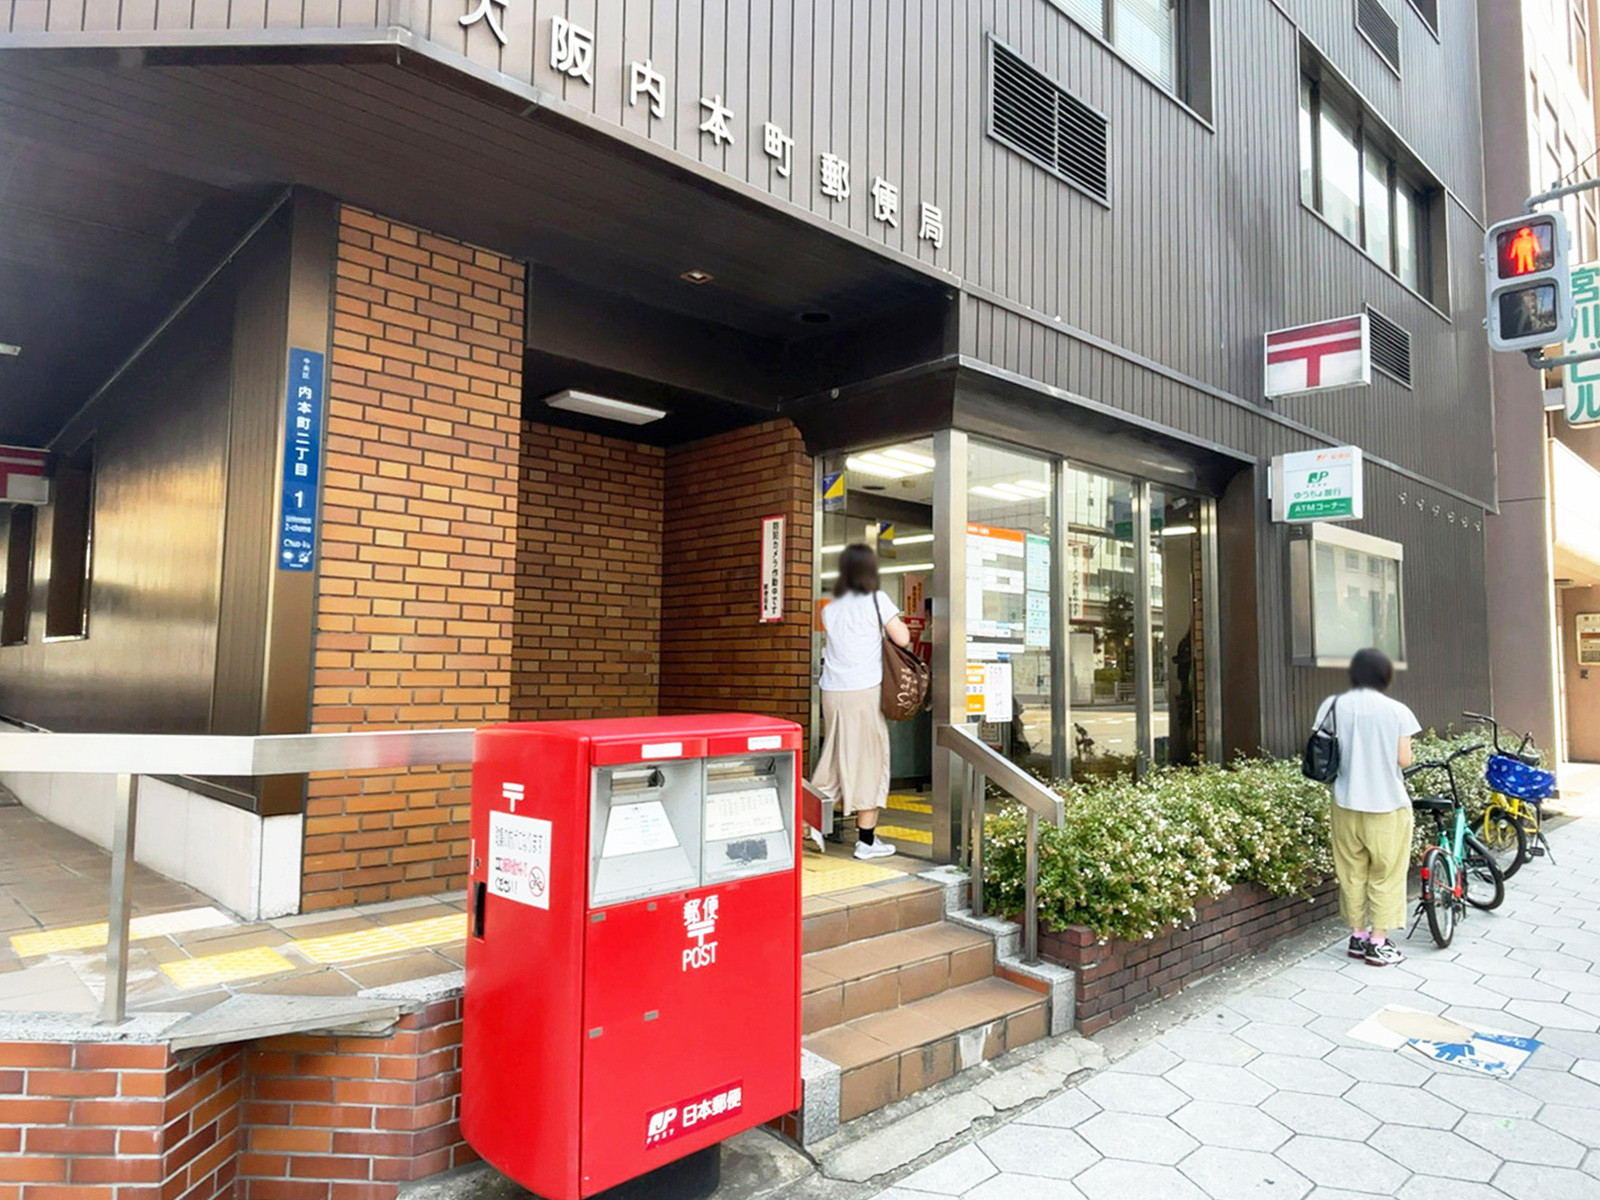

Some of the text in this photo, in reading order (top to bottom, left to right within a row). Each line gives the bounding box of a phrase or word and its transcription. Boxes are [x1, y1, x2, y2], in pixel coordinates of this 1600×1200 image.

[1567, 267, 1600, 421] 宮川ビル
[294, 385, 313, 477] 内本町二丁目
[295, 490, 304, 508] 1
[1295, 501, 1347, 512] ATMコーナー
[683, 894, 719, 926] 郵便
[682, 941, 719, 972] POST
[682, 1087, 742, 1128] 日本郵便
